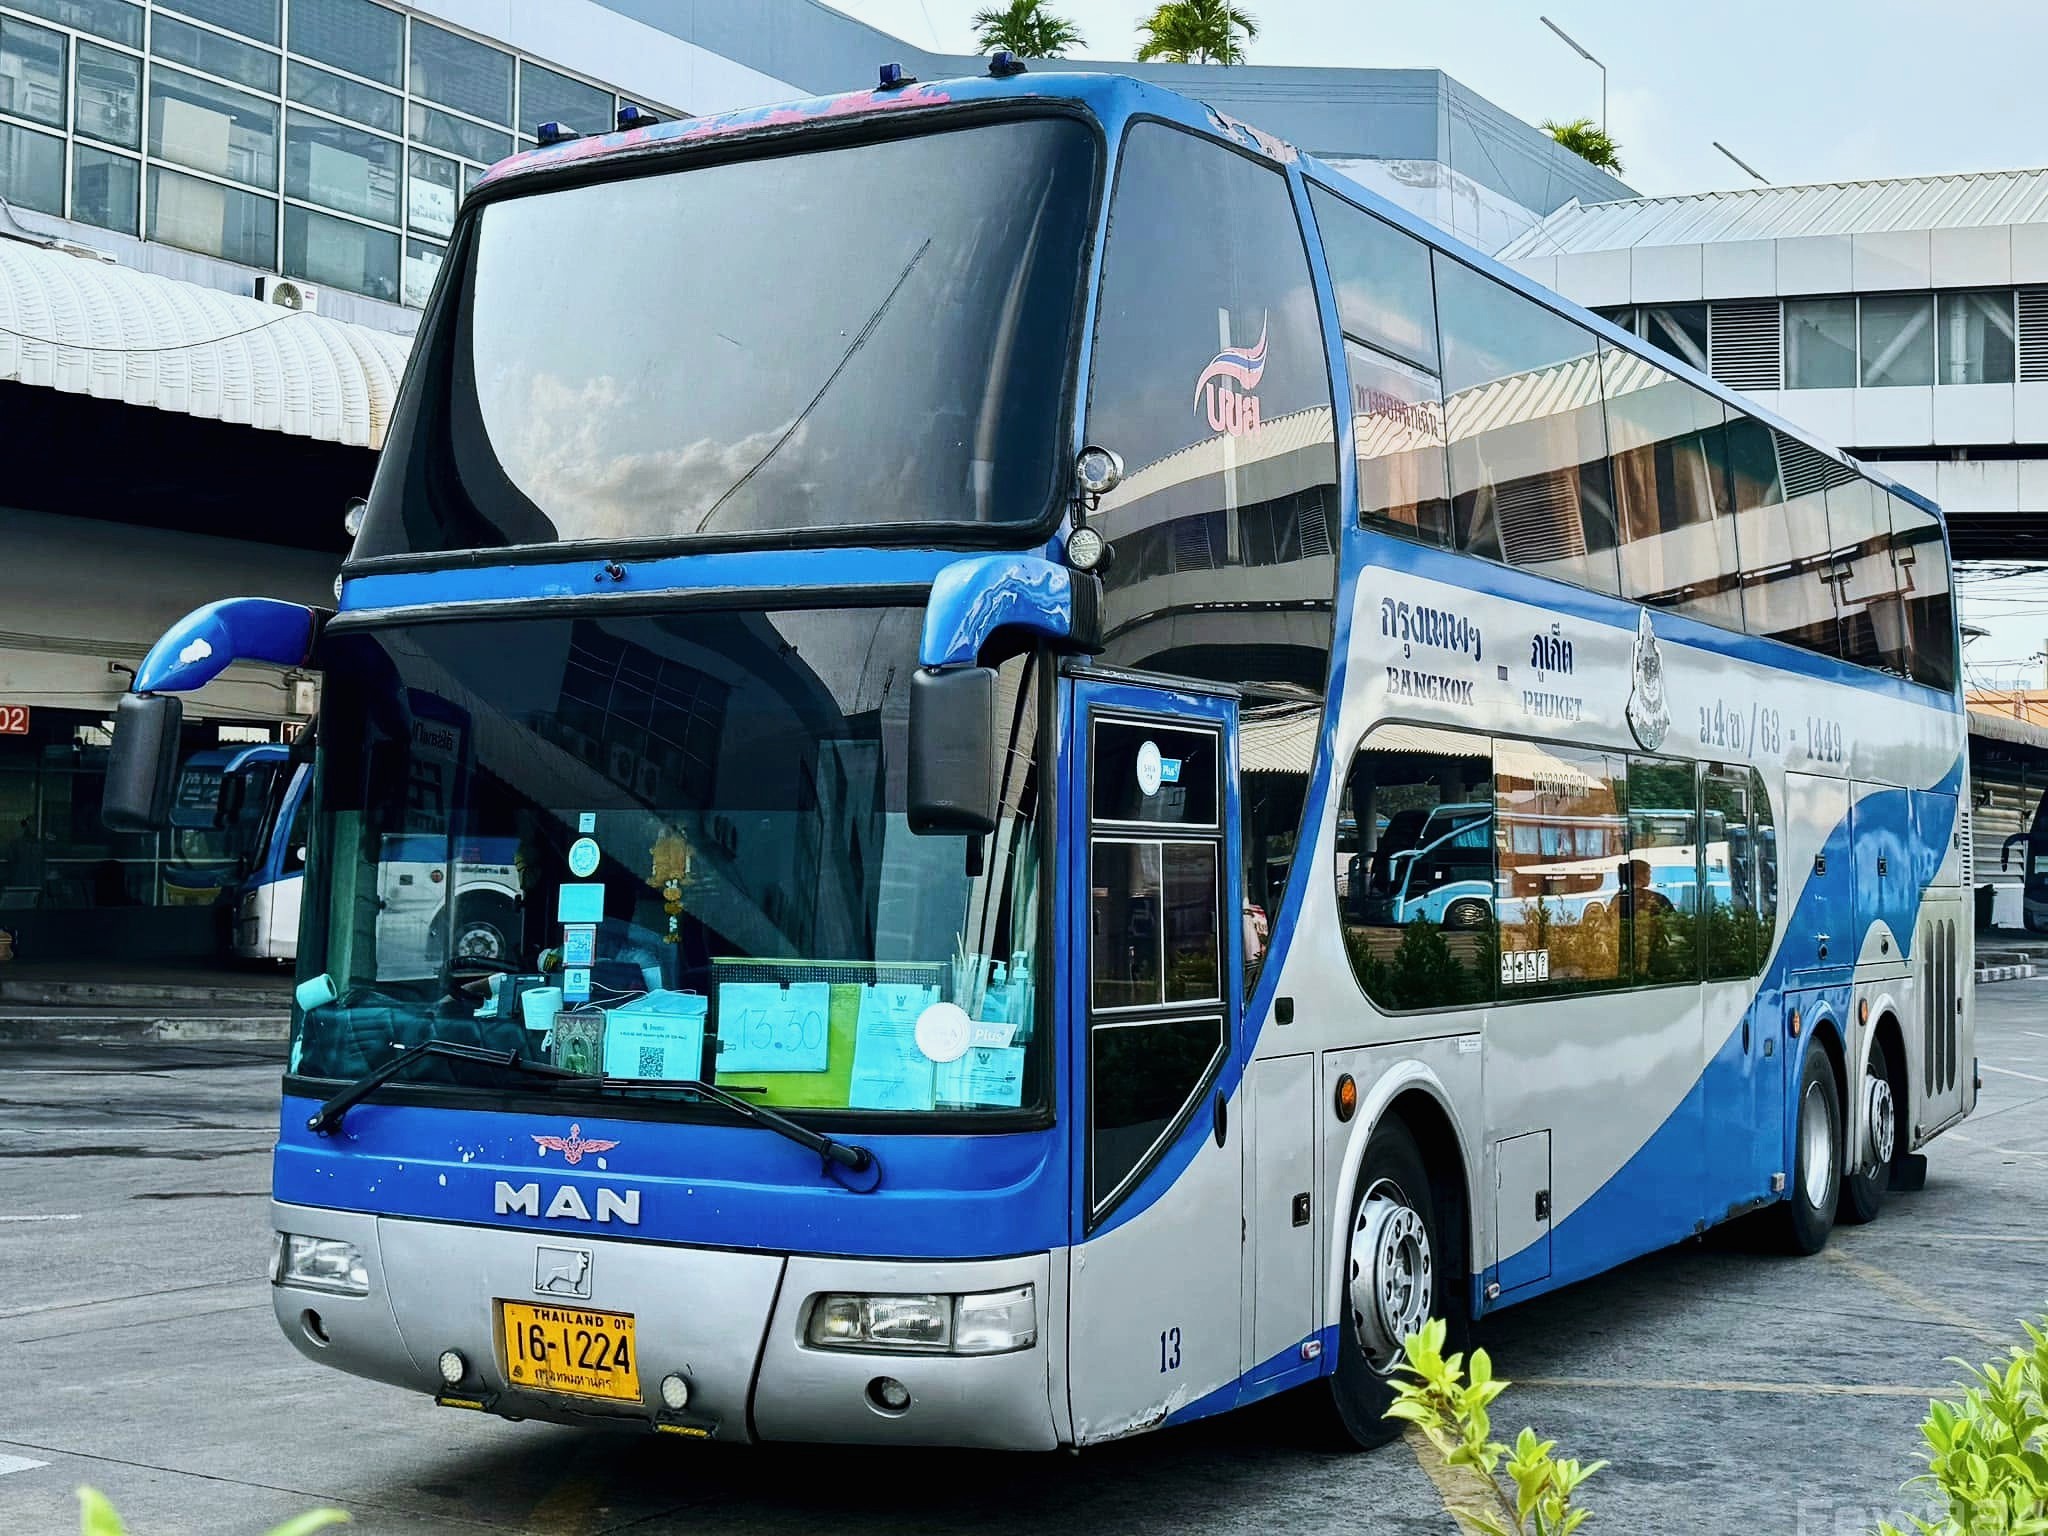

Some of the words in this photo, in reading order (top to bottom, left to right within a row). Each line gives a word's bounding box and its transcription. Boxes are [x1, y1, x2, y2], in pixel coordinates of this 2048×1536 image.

[1381, 596, 1482, 662] กรุงเทพฯ
[1530, 622, 1573, 683] ภูเก็ต
[1386, 666, 1474, 706] BANGKOK
[1522, 690, 1582, 721] PHUKET
[1807, 716, 1842, 762] 1449
[735, 1008, 822, 1052] 13.30
[494, 1181, 640, 1225] MAN
[532, 1309, 604, 1328] THAILAND
[517, 1321, 630, 1374] 16-1224
[1160, 1326, 1181, 1374] 13
